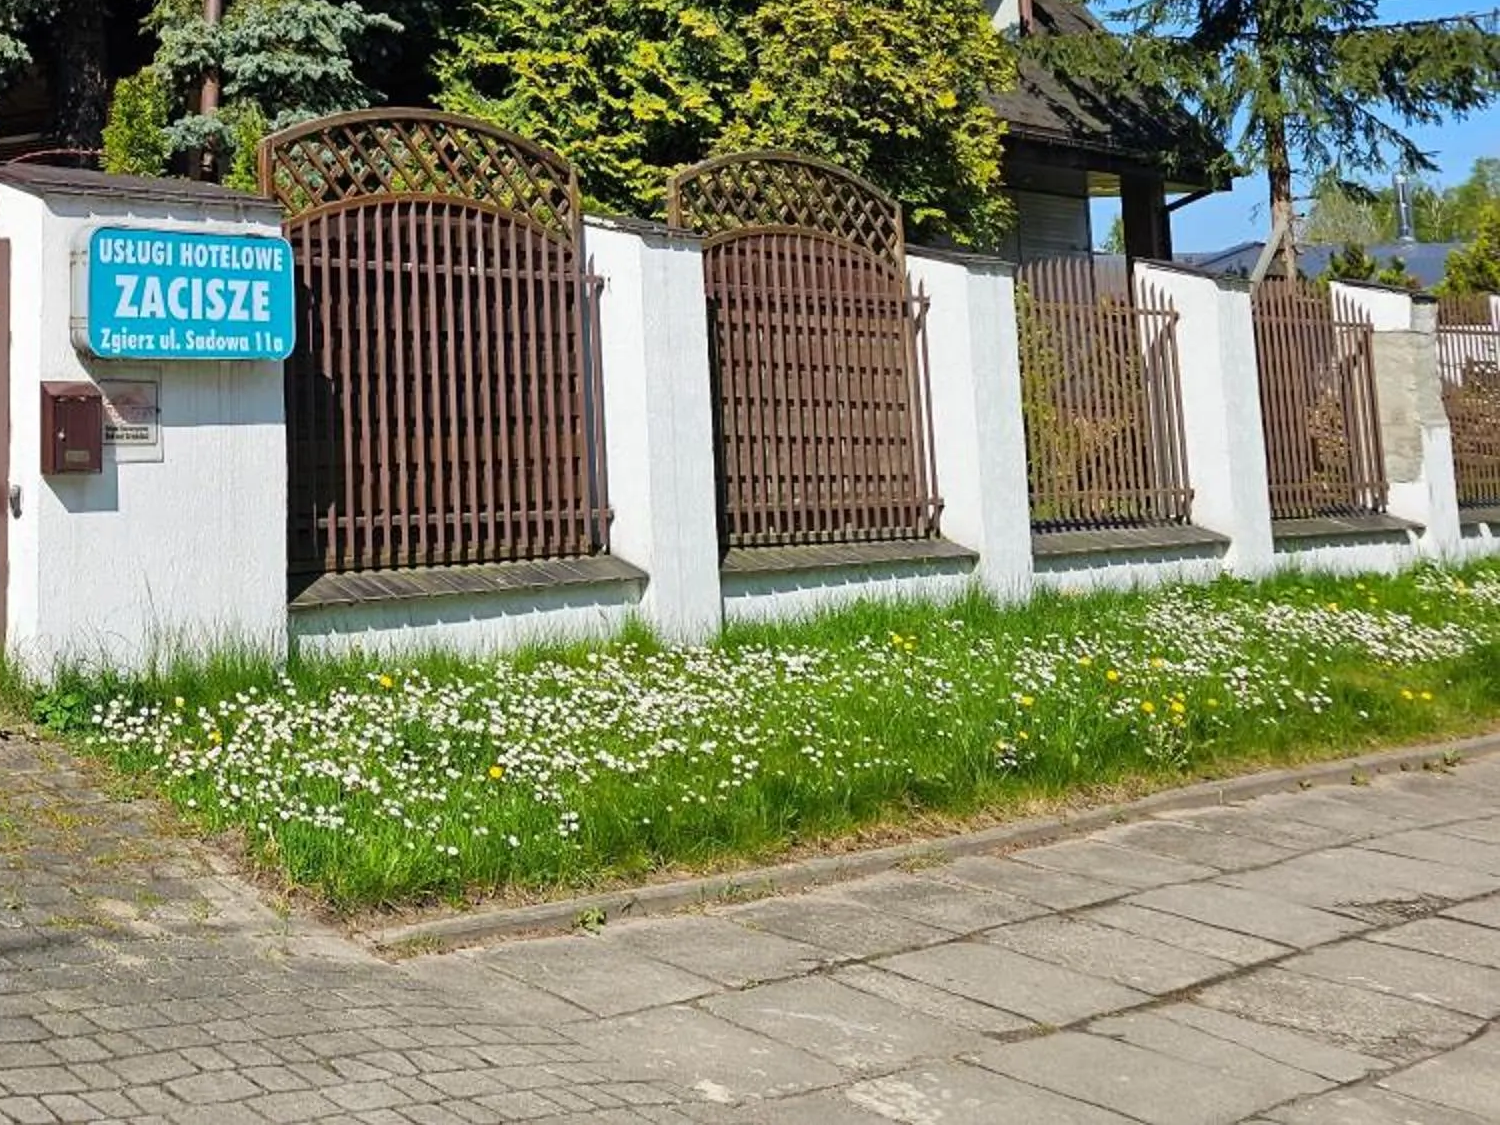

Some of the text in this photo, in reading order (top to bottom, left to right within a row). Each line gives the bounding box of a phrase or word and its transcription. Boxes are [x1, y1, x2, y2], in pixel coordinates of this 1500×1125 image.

[100, 238, 283, 271] USŁUGI HOTELOWE
[114, 275, 270, 321] ZACISZE
[100, 328, 283, 353] Zgierz ul. Sadowa 11a
